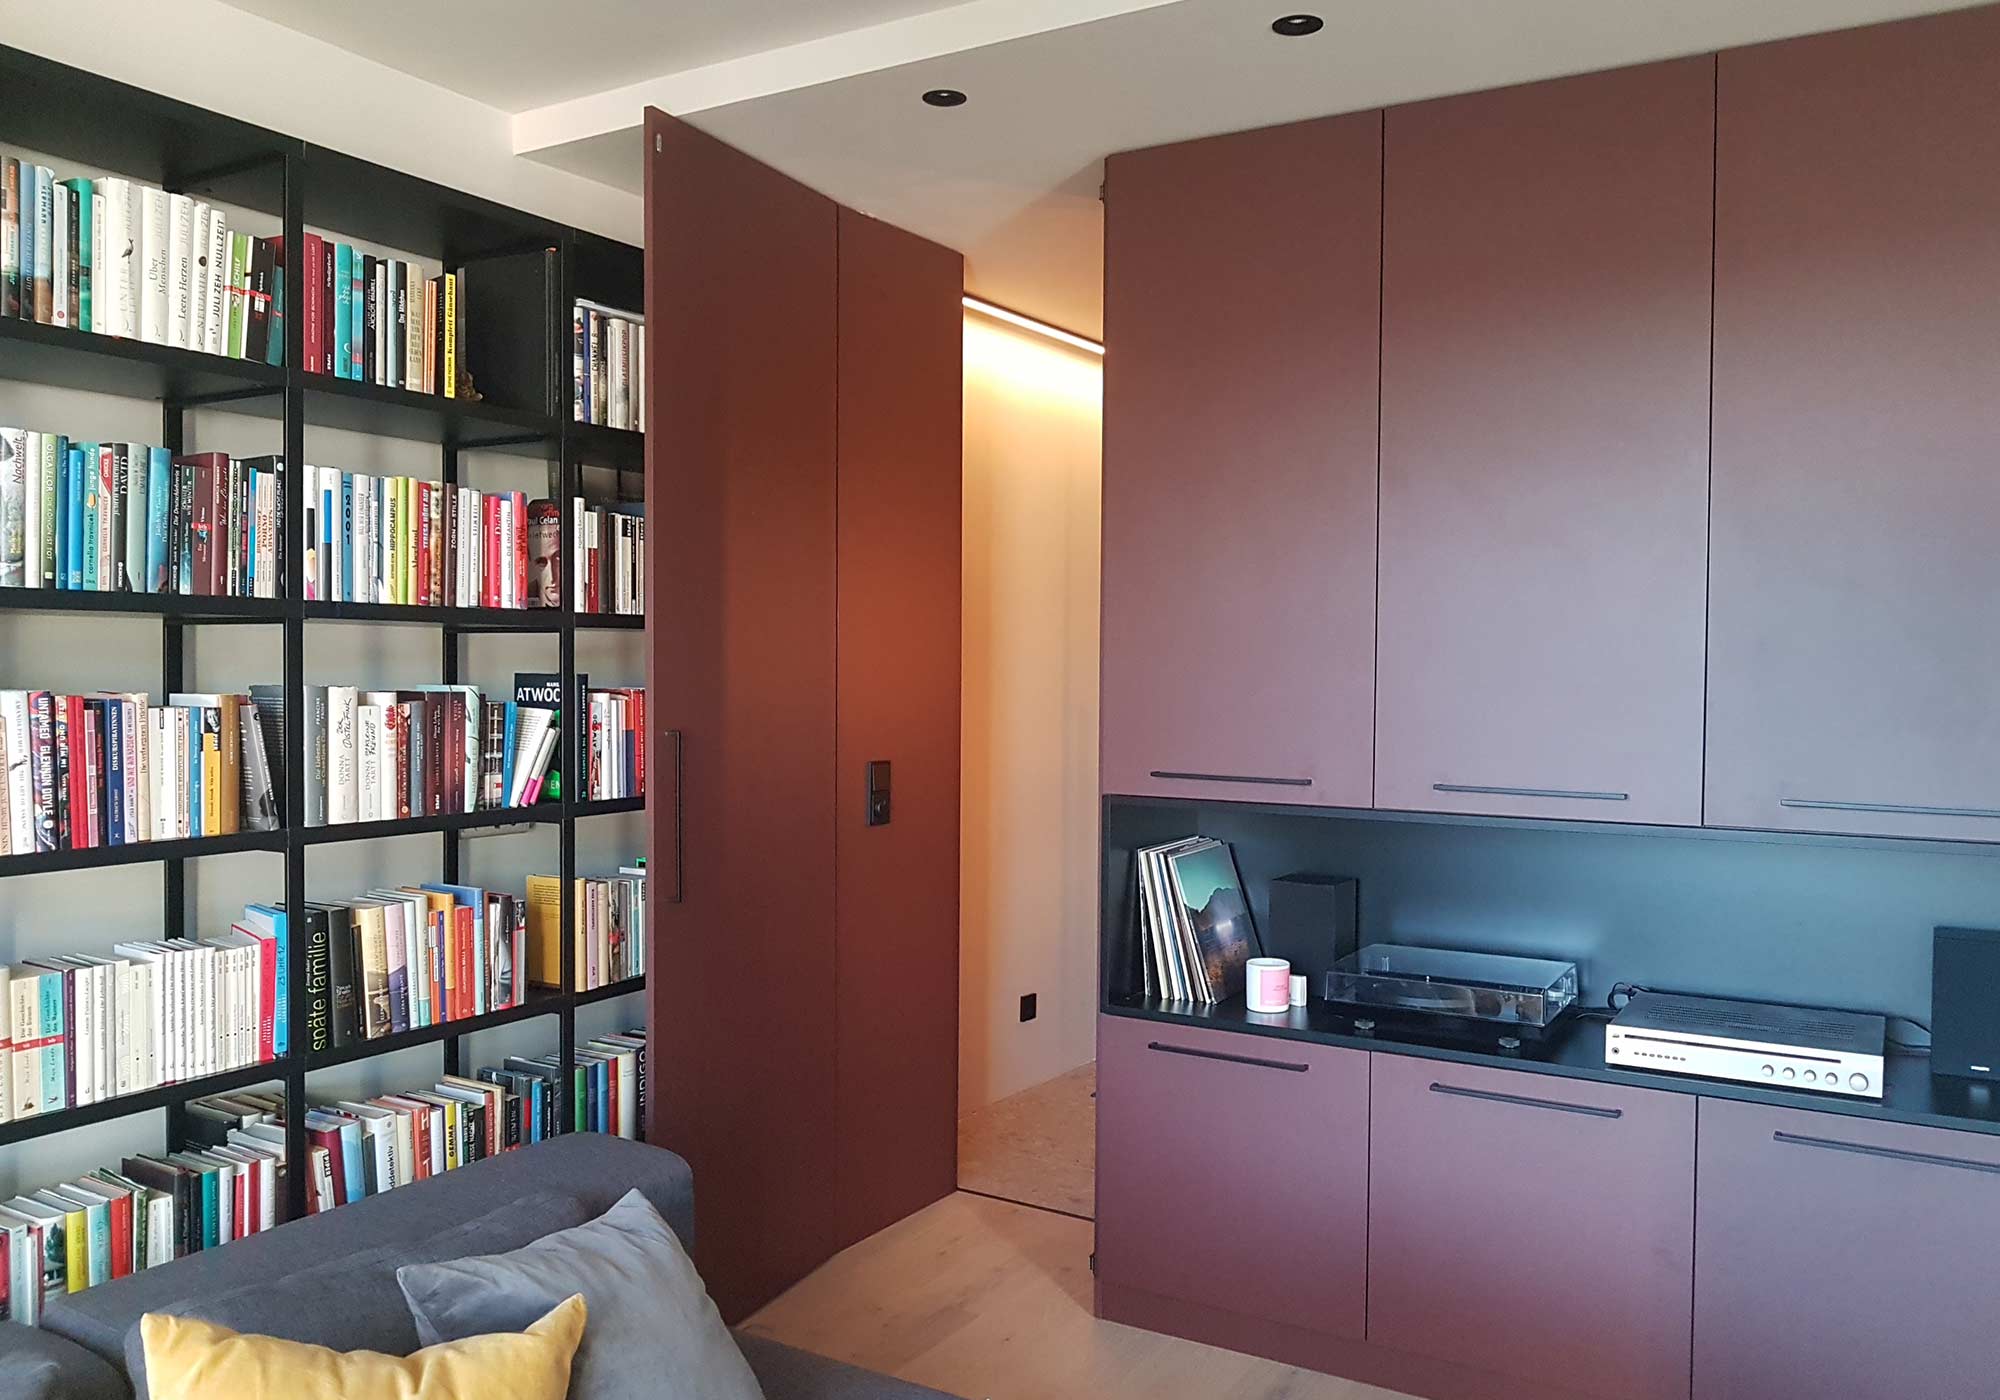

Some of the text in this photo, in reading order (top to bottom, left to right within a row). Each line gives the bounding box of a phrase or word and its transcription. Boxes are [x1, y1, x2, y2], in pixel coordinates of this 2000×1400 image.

[179, 201, 188, 221] ZEH
[149, 258, 158, 280] Über
[159, 249, 167, 294] Menschen
[178, 257, 188, 319] Leere Herzen
[213, 219, 224, 317] JULI ZEH NULLZEIT
[233, 257, 241, 287] SCHILF
[197, 272, 206, 329] NEUJAHR
[12, 437, 22, 485] Nachwelt
[88, 471, 96, 490] junge
[539, 516, 557, 524] Celan
[38, 697, 53, 815] UNTAMED GLENNON DOYLE
[111, 706, 119, 771] DISKURSPIRATINNEN
[308, 932, 328, 1050] späte familie
